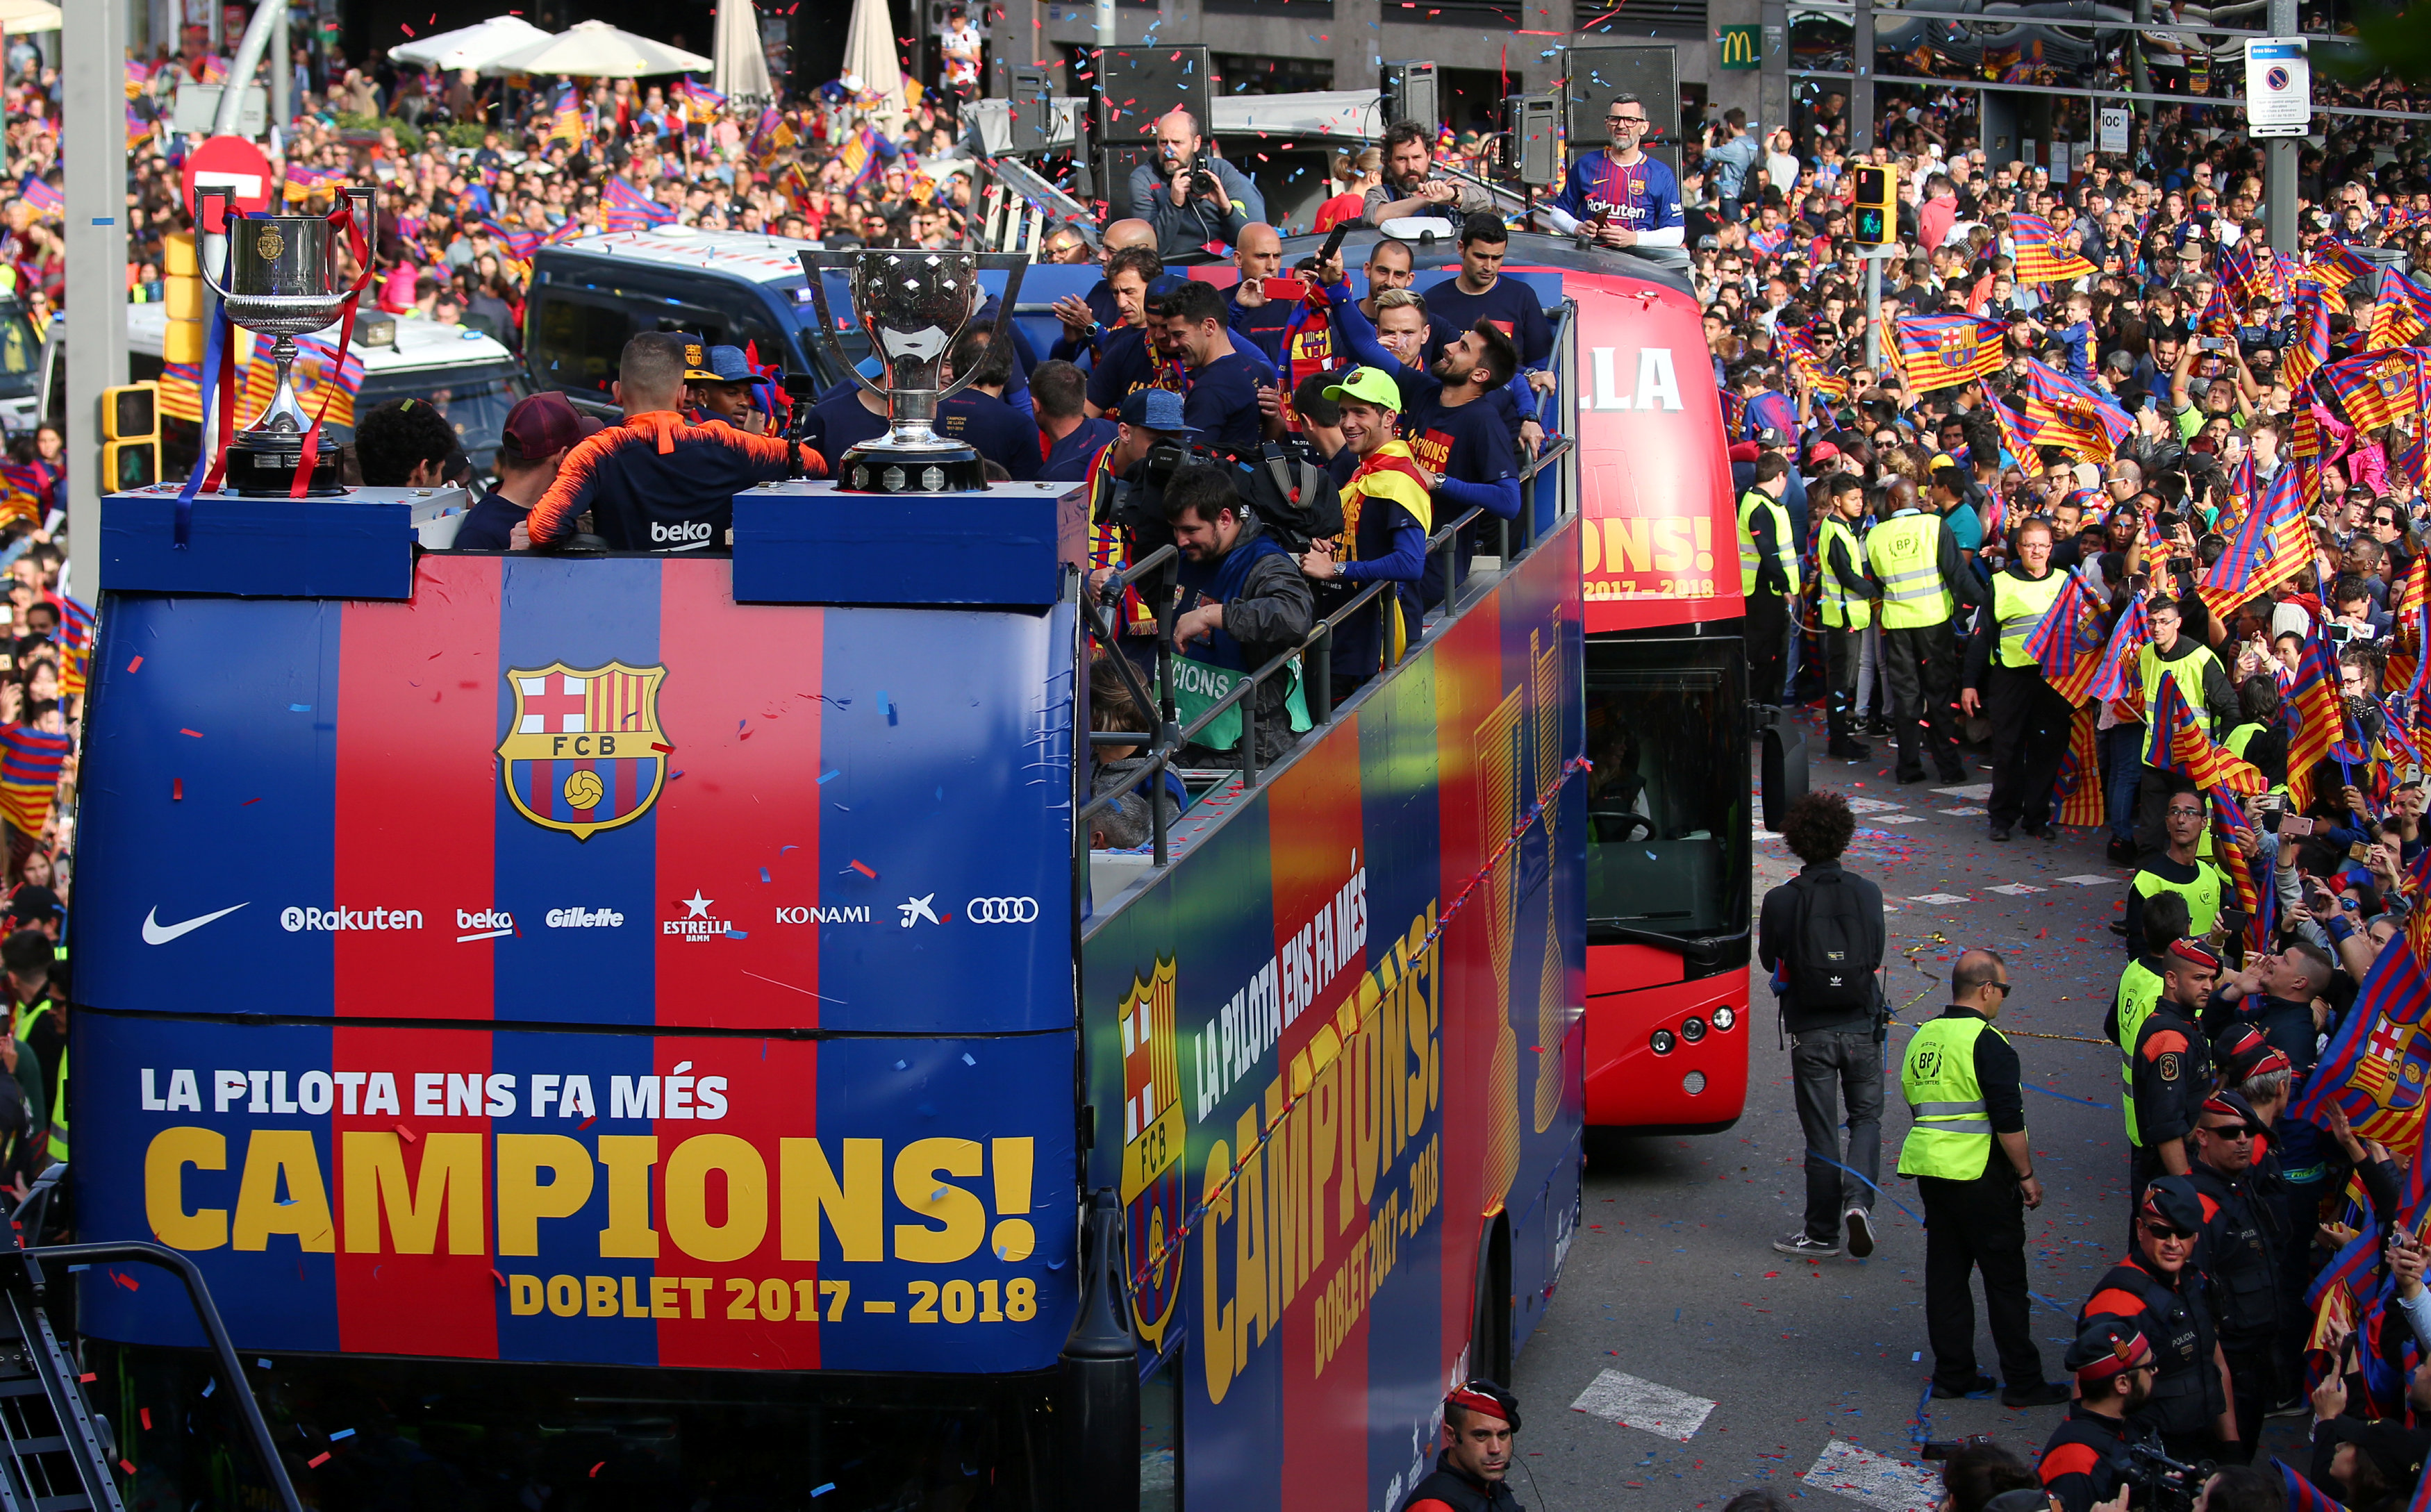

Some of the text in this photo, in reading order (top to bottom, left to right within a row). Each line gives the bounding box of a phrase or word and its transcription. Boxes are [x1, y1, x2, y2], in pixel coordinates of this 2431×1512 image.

[2102, 112, 2120, 127] ioc
[1587, 199, 1646, 219] Rakuten
[1579, 347, 1684, 410] LA
[2376, 369, 2393, 379] FCB
[651, 521, 713, 543] beko
[1896, 538, 1911, 550] BP
[1584, 581, 1637, 602] 2017
[1660, 579, 1716, 600] 2018
[554, 736, 617, 757] FCB
[306, 906, 423, 931] Rakuten
[456, 908, 513, 929] beko
[545, 907, 624, 929] Gillette
[775, 906, 871, 924] KONAMI
[663, 920, 733, 935] ESTRELLA
[1195, 847, 1368, 1124] LA PILOTA ENS FA MÉS
[1919, 1052, 1934, 1069] BP
[2387, 1047, 2405, 1082] FCB
[141, 1061, 729, 1120] LA PILOTA ENS FA MÉS
[1141, 1122, 1166, 1183] FCB
[1202, 897, 1440, 1405] CAMPIONS!
[144, 1126, 1036, 1264] CAMPIONS!
[1315, 1230, 1368, 1380] DOBLET
[1368, 1187, 1398, 1301] 2017
[1409, 1132, 1439, 1240] 2018
[509, 1274, 714, 1320] DOBLET
[726, 1277, 851, 1322] 2017
[908, 1278, 1038, 1324] 2018
[2172, 1331, 2196, 1348] POLICIA
